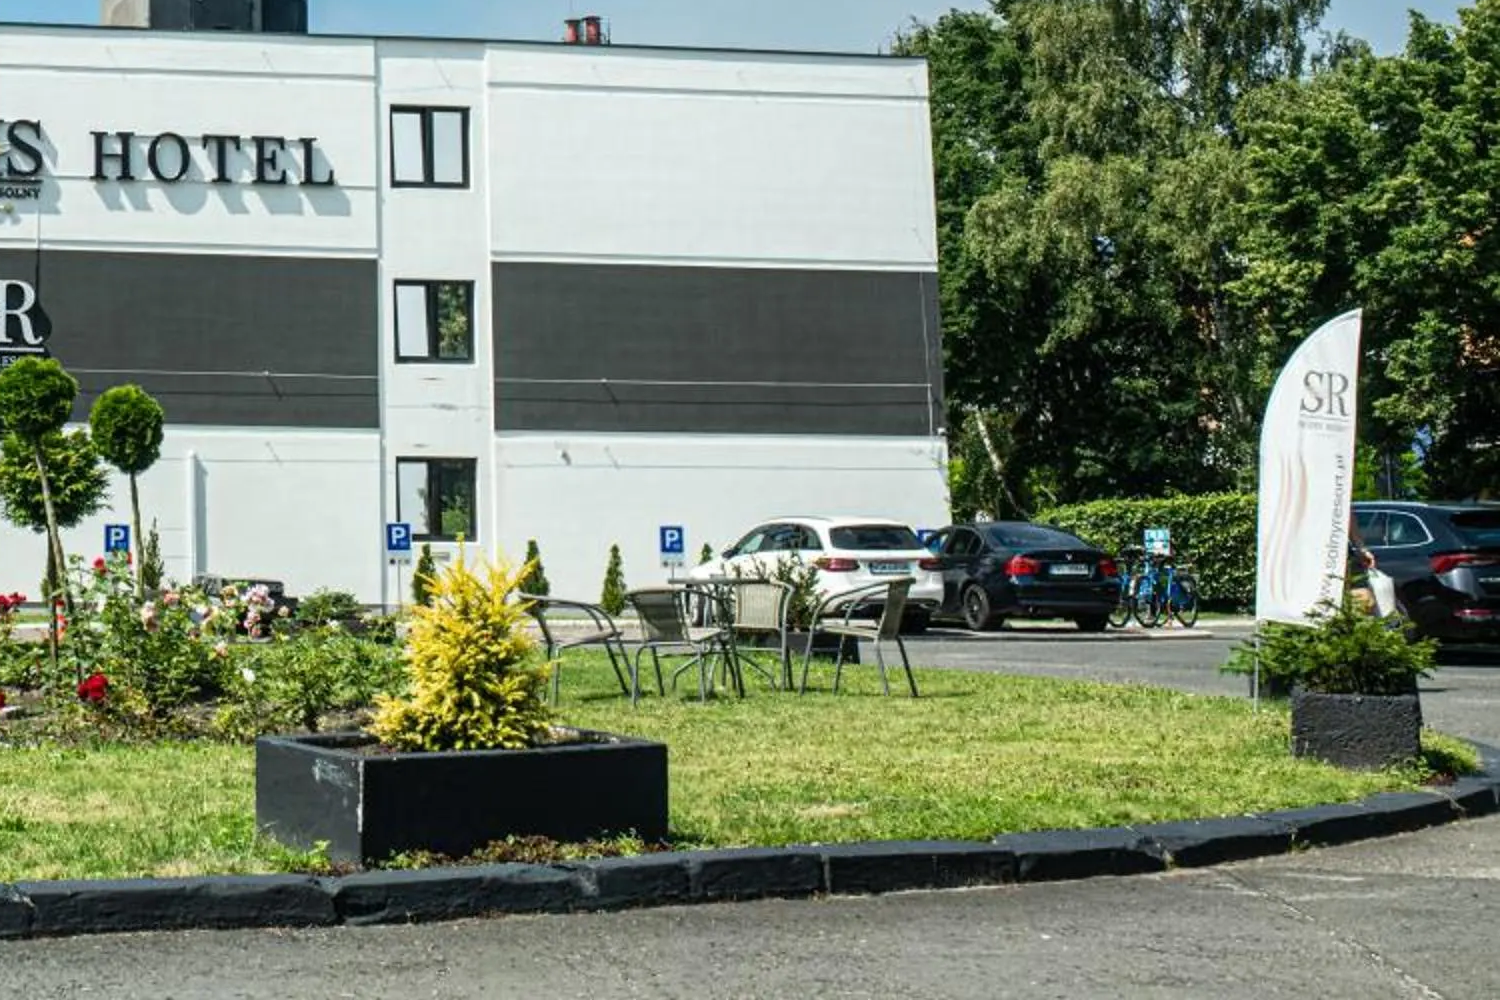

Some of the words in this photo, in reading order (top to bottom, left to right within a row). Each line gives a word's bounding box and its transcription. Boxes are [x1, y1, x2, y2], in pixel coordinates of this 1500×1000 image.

[89, 131, 335, 187] HOTEL
[1300, 370, 1349, 417] SR
[111, 527, 125, 548] P
[391, 526, 406, 546] P
[665, 529, 679, 549] P
